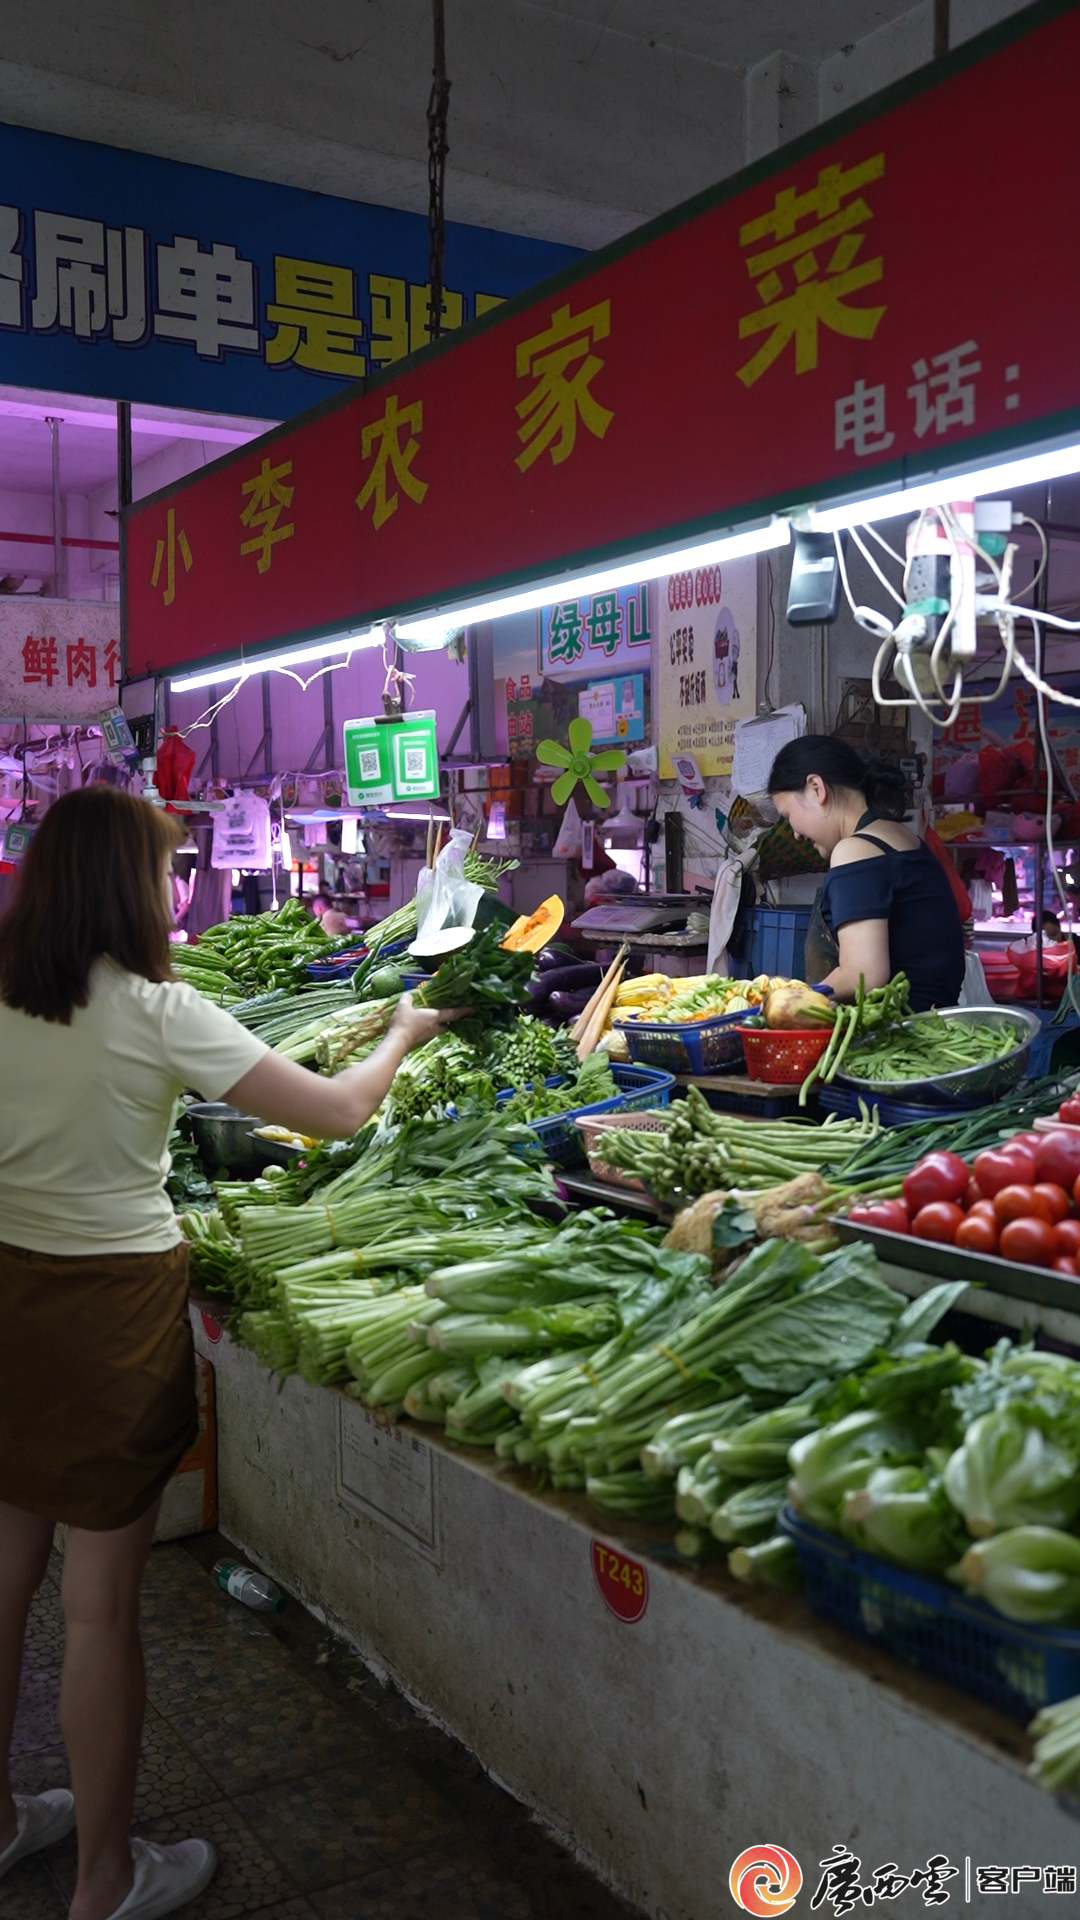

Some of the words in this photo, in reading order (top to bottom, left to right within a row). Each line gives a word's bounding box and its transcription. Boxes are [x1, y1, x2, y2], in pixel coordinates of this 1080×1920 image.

[0, 204, 508, 377] 刷单是骗
[150, 152, 886, 607] 小李农家菜
[595, 1545, 644, 1596] T243
